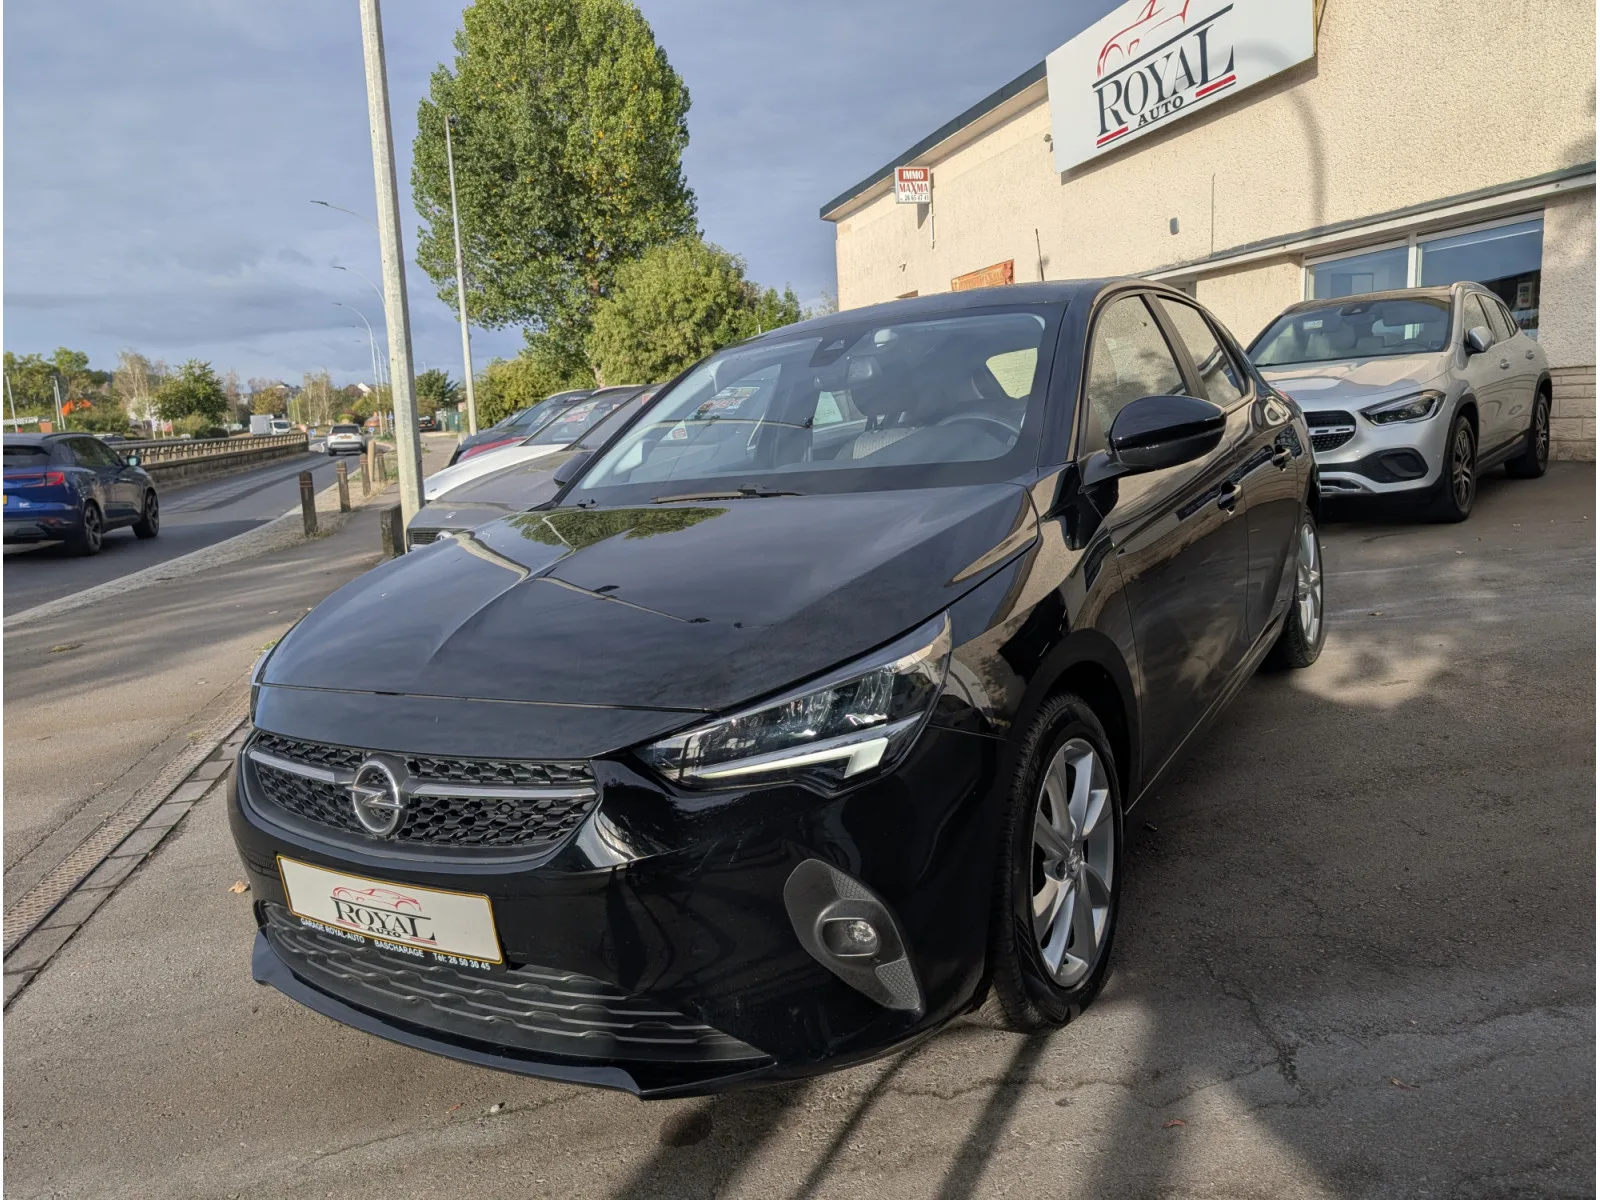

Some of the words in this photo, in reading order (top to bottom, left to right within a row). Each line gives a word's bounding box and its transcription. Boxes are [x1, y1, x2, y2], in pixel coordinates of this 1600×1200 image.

[1094, 23, 1235, 138] ROYAL
[1137, 95, 1184, 127] AUTO
[899, 182, 929, 194] MAXMA
[903, 170, 925, 180] IMMO
[333, 900, 436, 941] ROYAL
[367, 926, 401, 938] AUTO
[300, 917, 326, 932] GARAGE
[325, 925, 365, 944] ROYAL-AUTO
[374, 939, 425, 958] BASCHARAGE
[448, 955, 458, 965] 26
[459, 958, 469, 967] 50
[470, 960, 480, 969] 30
[480, 962, 491, 971] 45
